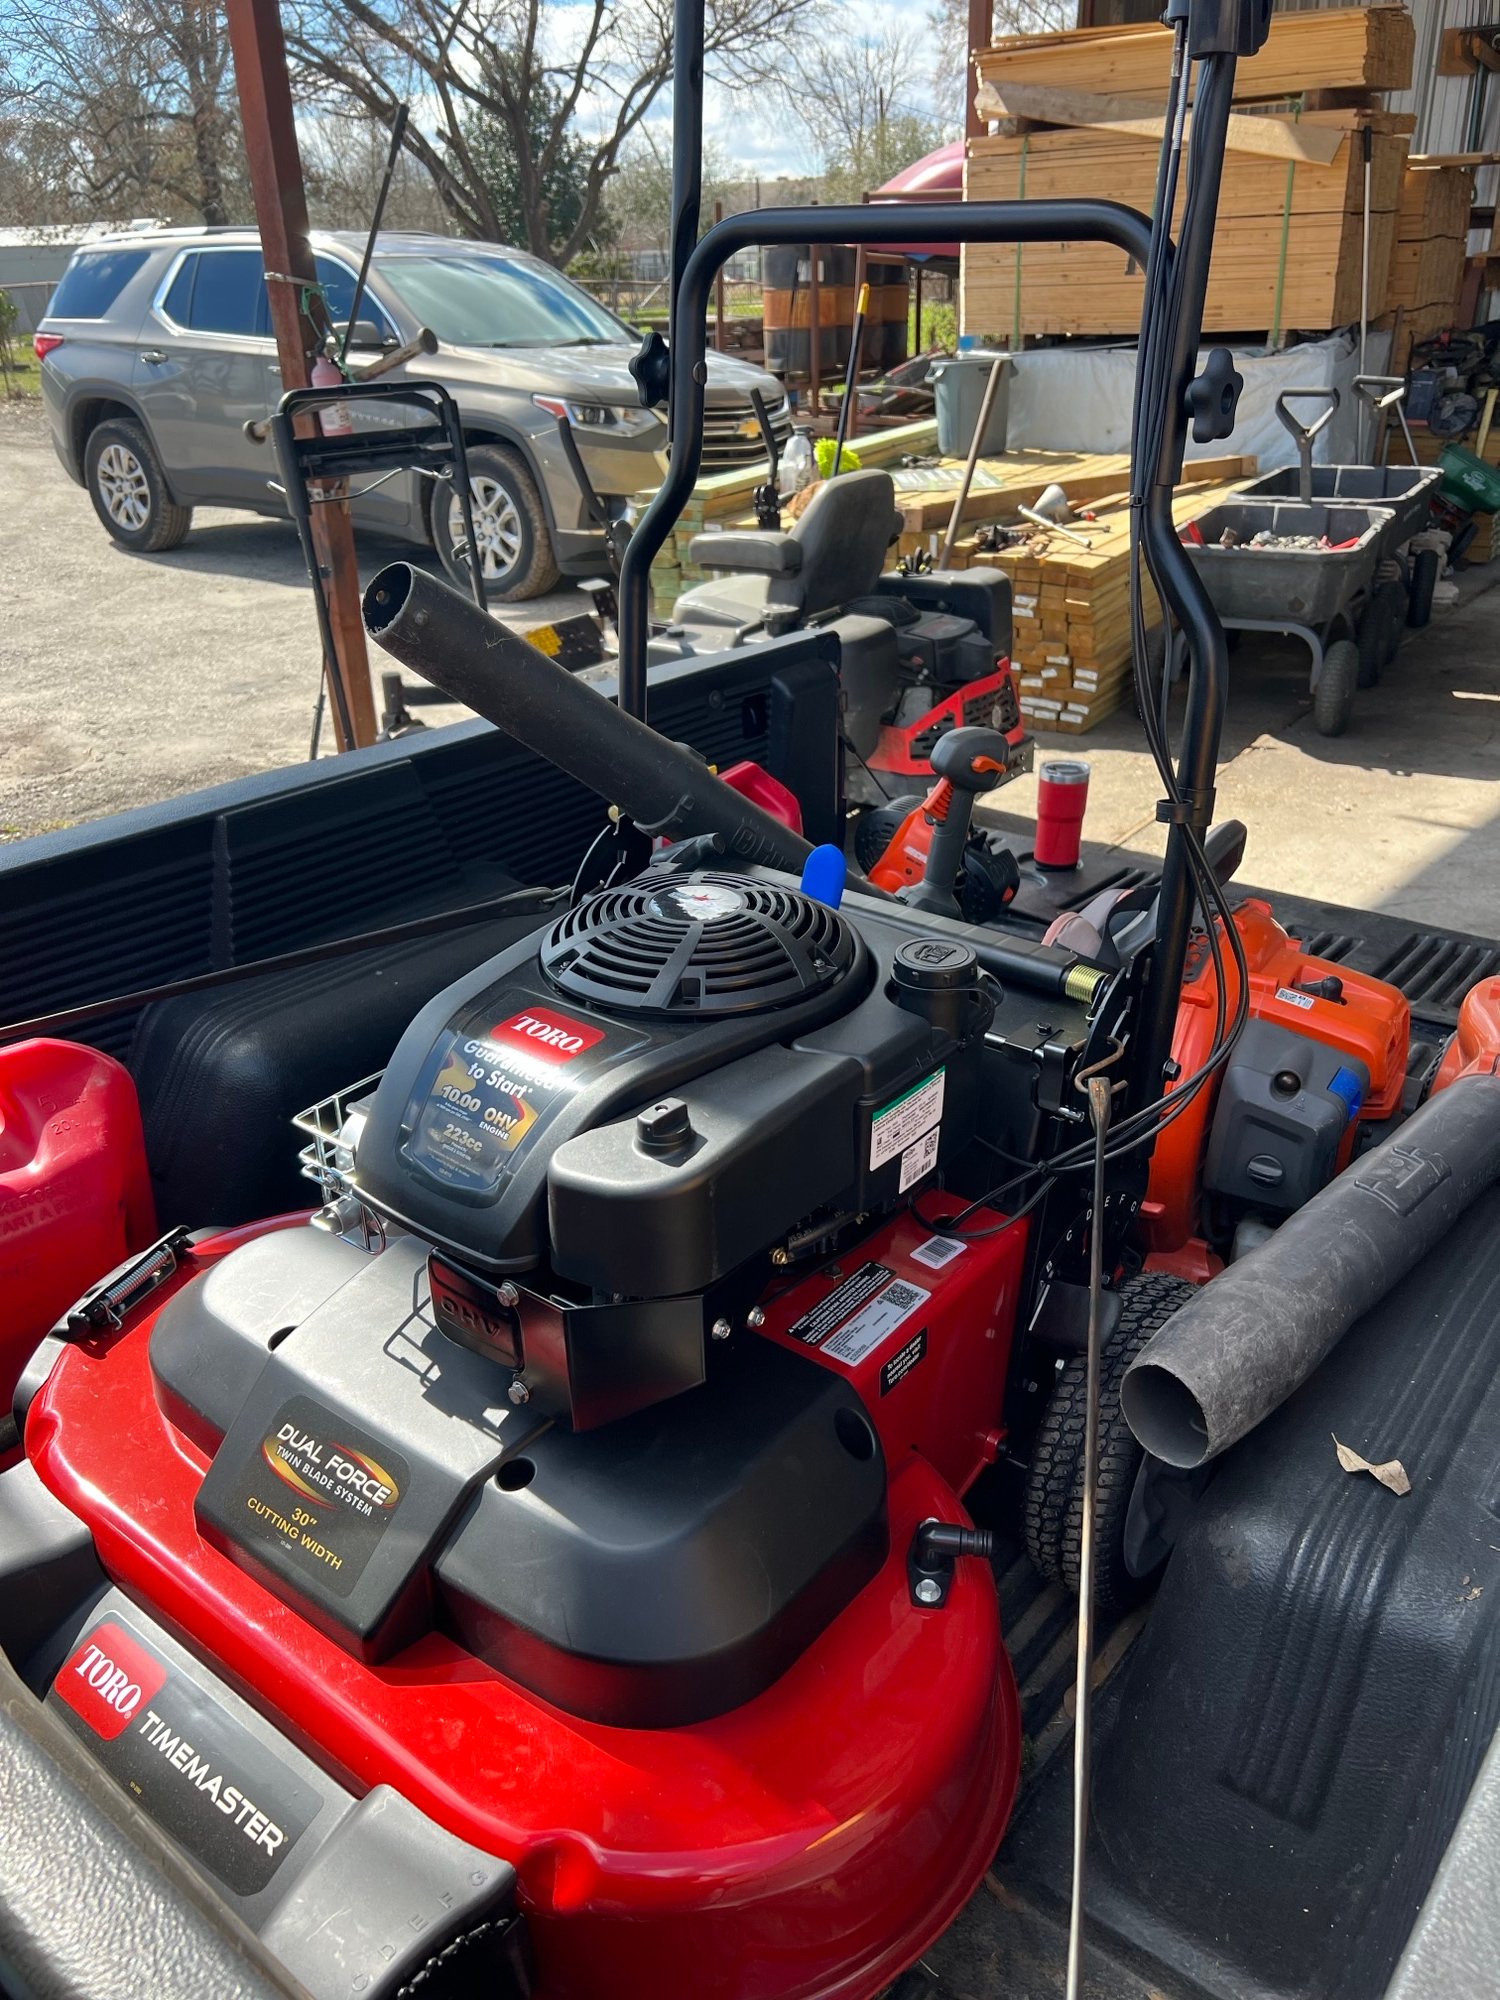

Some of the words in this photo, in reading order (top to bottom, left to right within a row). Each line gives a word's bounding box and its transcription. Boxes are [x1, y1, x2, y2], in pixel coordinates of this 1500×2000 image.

[511, 1016, 584, 1053] TORO
[467, 1062, 484, 1079] to
[441, 1085, 481, 1112] 10.00
[484, 1107, 519, 1130] OHV
[443, 1124, 484, 1152] 223cc
[478, 1121, 510, 1141] ENGINE
[1104, 1195, 1111, 1208] E
[441, 1294, 500, 1337] OHV
[275, 1445, 301, 1468] TWIN
[302, 1463, 334, 1490] BLADE
[334, 1485, 373, 1517] SYSTEM
[277, 1423, 324, 1463] DUAL
[324, 1454, 392, 1506] FORCE
[247, 1497, 300, 1539] CUTTING
[301, 1533, 343, 1571] WIDTH
[75, 1644, 142, 1716] TORO
[138, 1711, 284, 1856] TIMEMASTER
[378, 1944, 396, 1961] D
[408, 1914, 429, 1933] E
[437, 1892, 455, 1909] F
